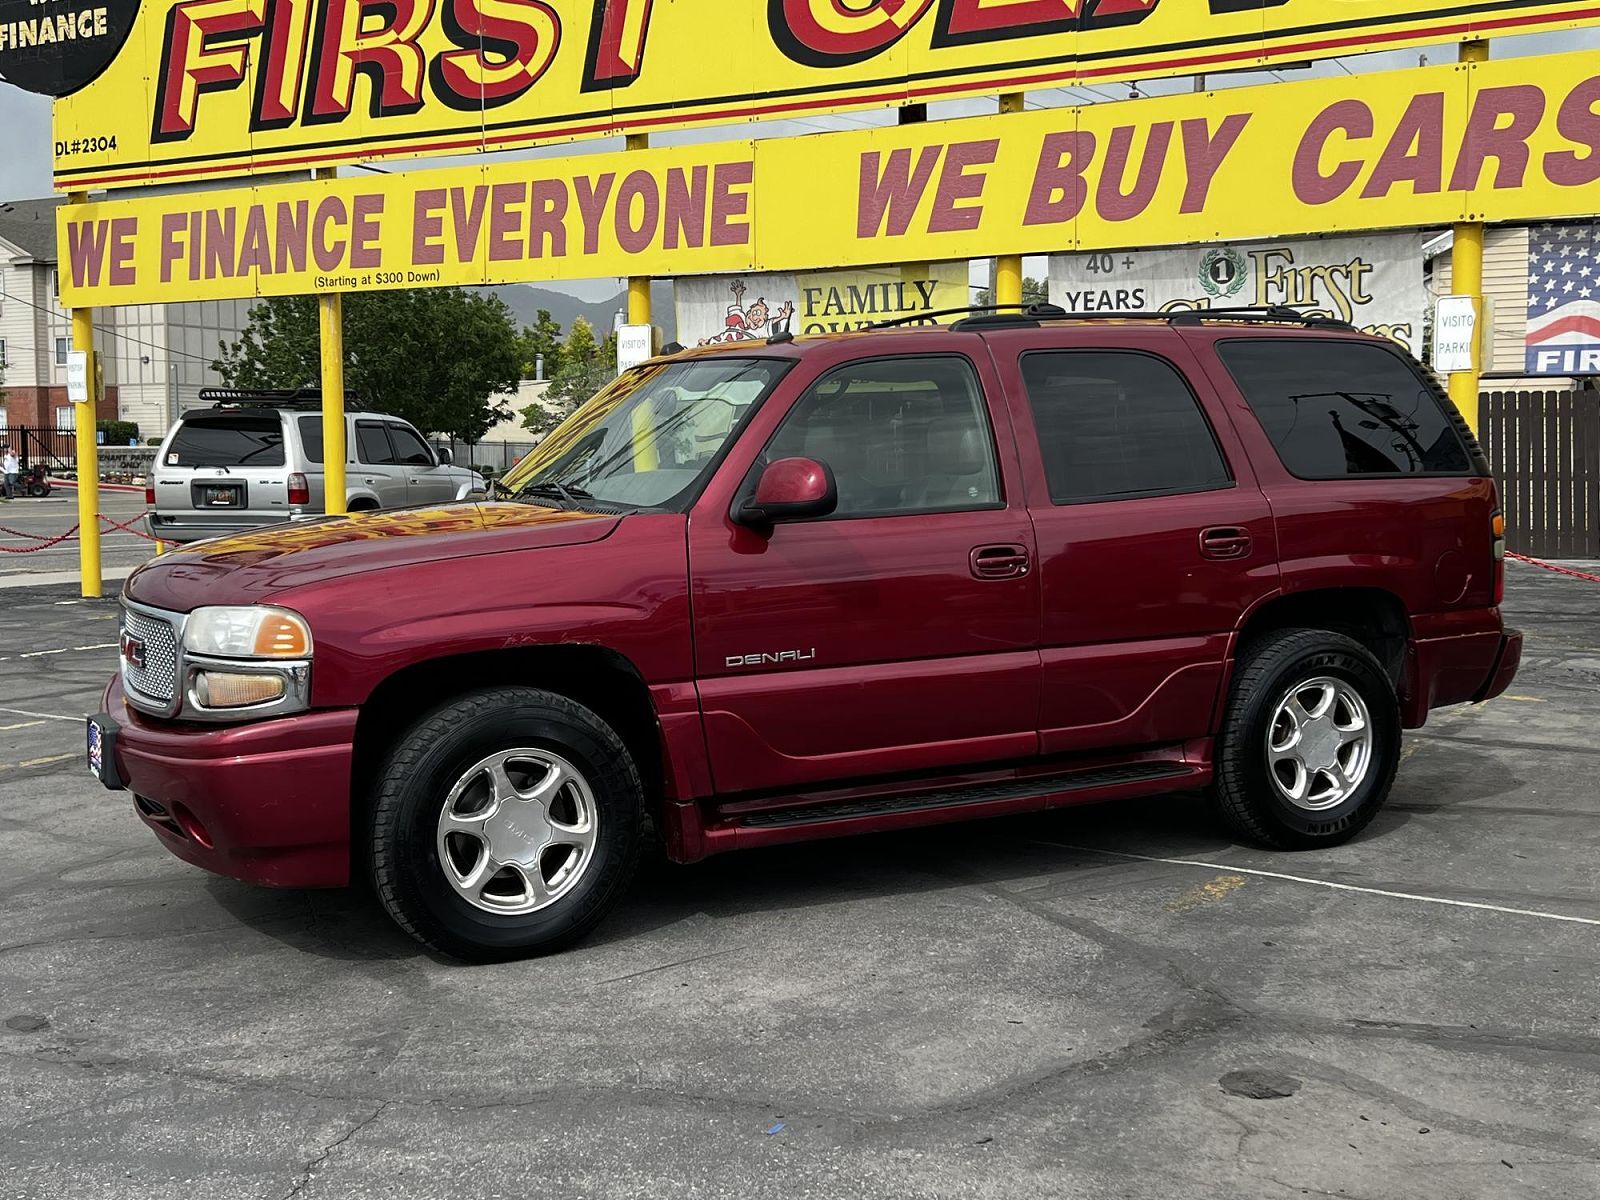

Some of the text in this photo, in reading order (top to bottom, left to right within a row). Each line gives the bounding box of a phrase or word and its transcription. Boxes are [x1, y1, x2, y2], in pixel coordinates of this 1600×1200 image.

[0, 7, 108, 51] FINANCE
[55, 135, 117, 157] DL#2304
[856, 75, 1600, 238] WE BUY CARS
[67, 160, 754, 288] WE FINANCE EVERYONE
[1086, 253, 1114, 274] 40
[314, 268, 440, 288] (Starting at $300 Down)
[1248, 248, 1374, 327] First
[803, 279, 939, 318] FAMILY
[1065, 288, 1145, 312] YEARS
[621, 339, 647, 349] VISITOR
[1536, 349, 1600, 373] FIR
[120, 461, 142, 469] ONLY
[725, 647, 816, 668] DENALI
